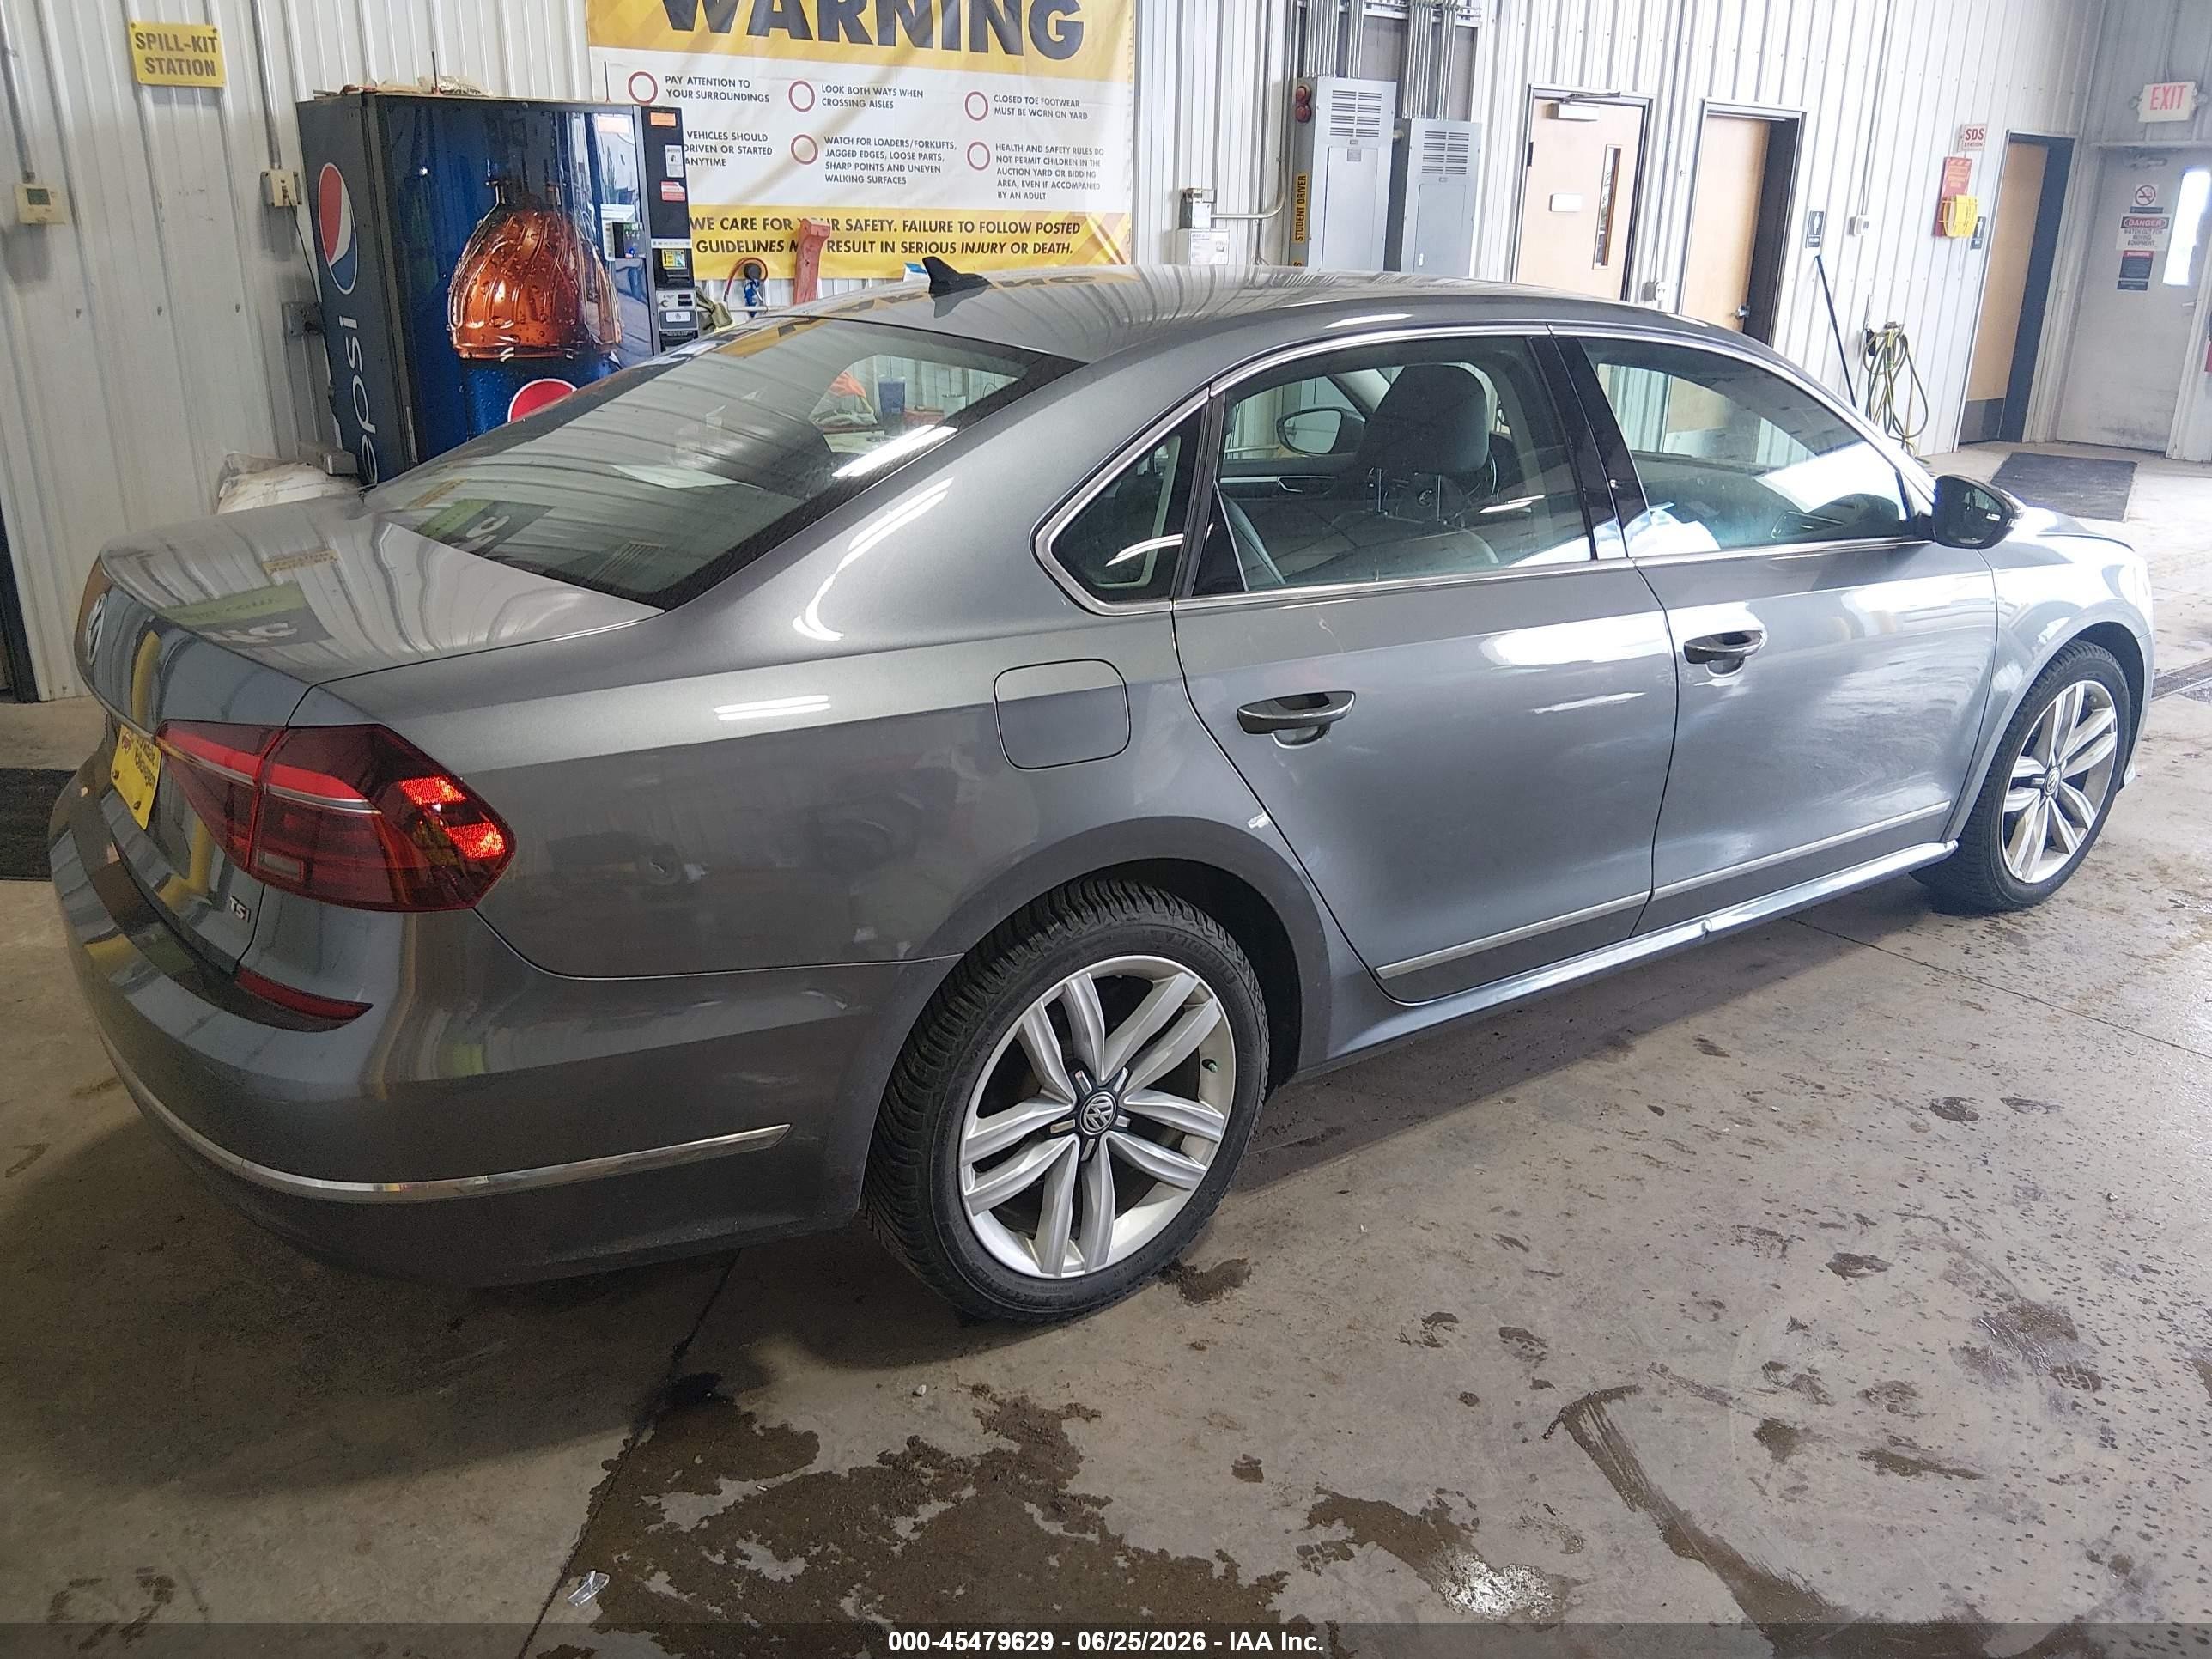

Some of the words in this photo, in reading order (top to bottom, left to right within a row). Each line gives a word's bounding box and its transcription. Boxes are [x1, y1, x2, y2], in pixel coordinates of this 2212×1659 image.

[661, 0, 1084, 60] WARNING
[135, 32, 217, 53] SPILL-KIT
[144, 56, 216, 76] STATION
[665, 76, 683, 84] PAY
[687, 76, 735, 87] ATTENTION
[738, 80, 750, 88] TO
[666, 89, 694, 99] YOUR
[696, 90, 770, 103] SURROUNDINGS
[822, 84, 844, 94] LOOK
[848, 86, 871, 95] BOTH
[873, 88, 897, 96] WAYS
[900, 89, 923, 98] WHEN
[2150, 85, 2186, 110] EXIT
[822, 98, 866, 108] CROSSING
[869, 100, 894, 109] AISLES
[994, 94, 1022, 104] CLOSED
[1025, 96, 1039, 105] TOE
[1041, 97, 1079, 107] FOOTWEAR
[994, 107, 1015, 116] MUST
[1018, 108, 1026, 117] BE
[1029, 109, 1053, 118] WORN
[1069, 112, 1088, 120] YARD
[687, 131, 728, 141] VEHICLES
[732, 131, 768, 142] SHOULD
[1965, 128, 1985, 141] SDS
[720, 145, 735, 154] OR
[738, 146, 773, 155] STARTED
[824, 136, 854, 146] WATCH
[856, 137, 871, 146] FOR
[874, 137, 957, 151] LOADERS/FORKLIFTS,
[996, 143, 1024, 152] HEALTH
[1026, 144, 1042, 153] AND
[1046, 146, 1070, 155] SAFETY
[1073, 147, 1092, 155] RULES
[1095, 148, 1104, 156] DO
[825, 149, 857, 158] JAGGED
[860, 150, 887, 161] EDGES,
[890, 151, 915, 161] LOOSE
[919, 153, 945, 162] PARTS,
[1015, 156, 1041, 165] PERMIT
[1043, 157, 1078, 167] CHILDREN
[685, 158, 726, 167] ANYTIME
[825, 161, 852, 170] SHARP
[854, 162, 884, 172] POINTS
[887, 164, 905, 173] AND
[908, 165, 941, 173] UNEVEN
[825, 174, 864, 184] WALKING
[867, 175, 907, 185] SURFACES
[996, 167, 1030, 176] AUCTION
[1033, 168, 1053, 177] YARD
[1055, 169, 1065, 178] OR
[1068, 170, 1096, 179] BIDDING
[997, 179, 1018, 189] AREA,
[1022, 180, 1041, 189] EVEN
[1297, 175, 1307, 204] DRIVER
[690, 216, 714, 230] WE
[720, 217, 757, 230] CARE
[763, 218, 793, 231] FOR
[845, 218, 897, 232] SAFETY.
[902, 220, 953, 233] FAILURE
[957, 221, 975, 234] TO
[979, 221, 1032, 234] FOLLOW
[1036, 222, 1080, 234] POSTED
[1295, 206, 1305, 242] STUDENT
[2128, 218, 2162, 227] DANGER
[696, 240, 785, 253] GUIDELINES
[827, 240, 876, 253] RESULT
[880, 241, 896, 253] IN
[901, 241, 957, 254] SERIOUS
[961, 242, 1006, 254] INJURY
[1010, 242, 1029, 254] OR
[1032, 242, 1073, 254] DEATH.
[230, 896, 251, 923] TSI
